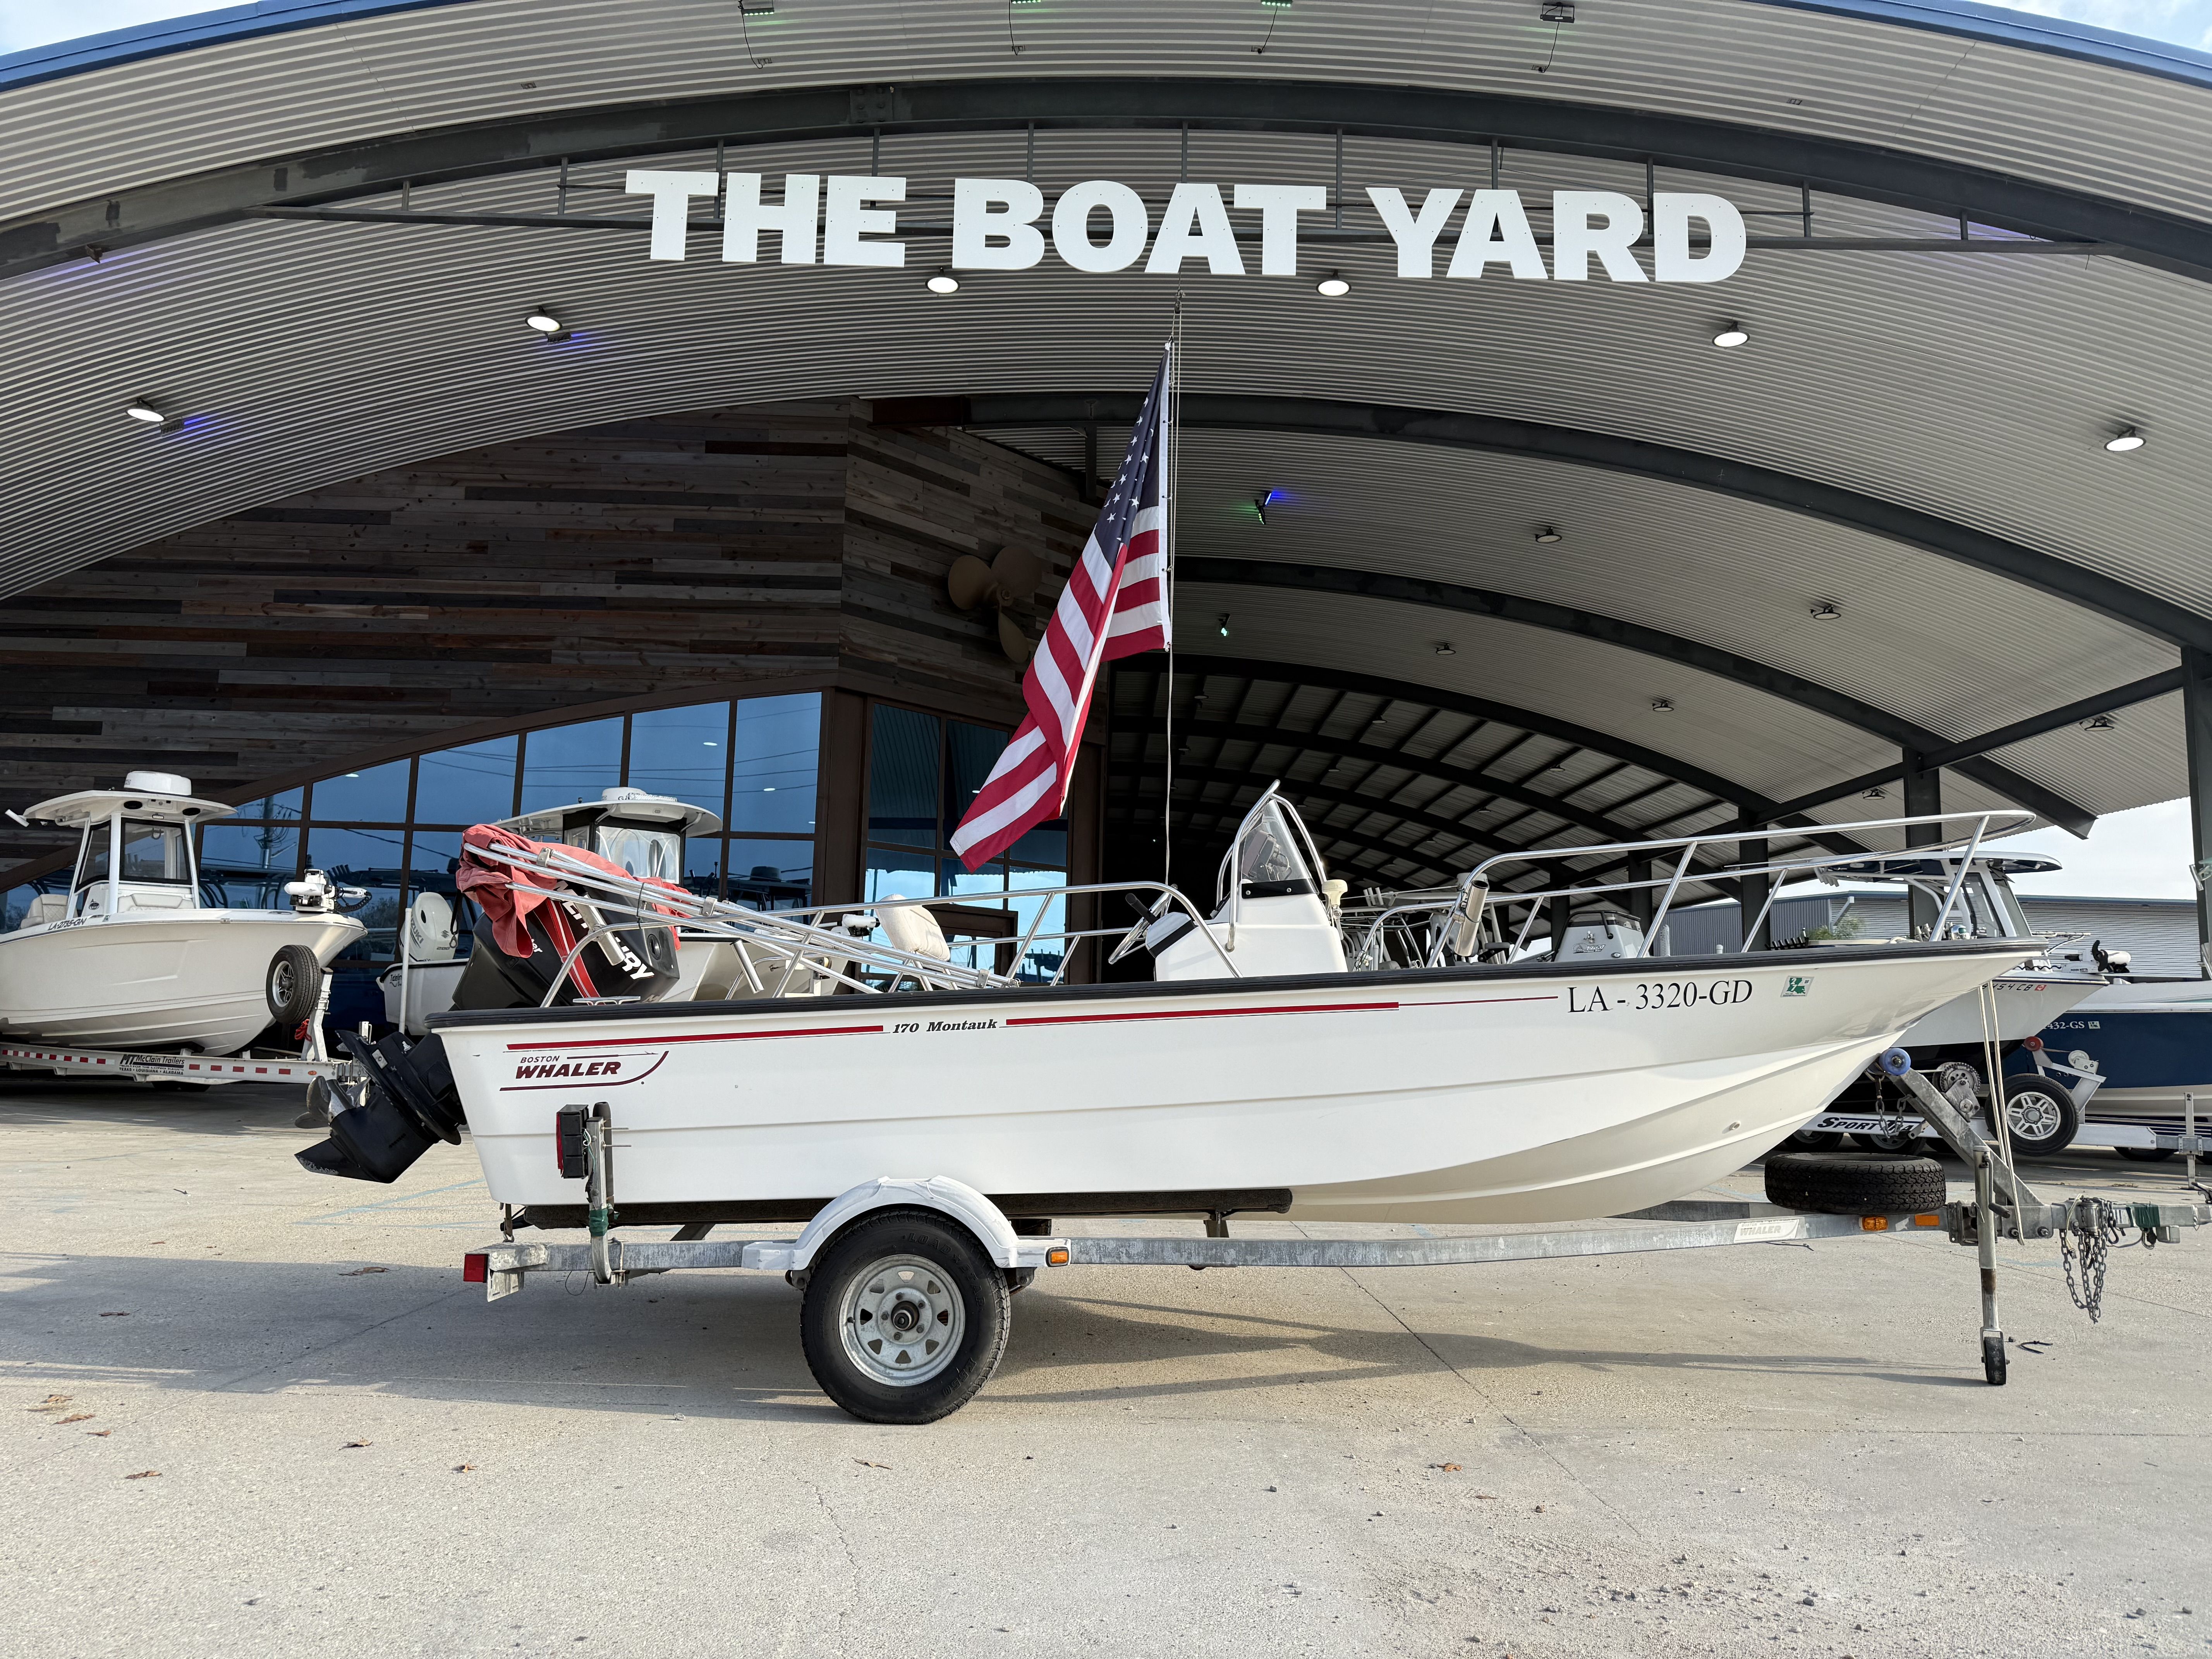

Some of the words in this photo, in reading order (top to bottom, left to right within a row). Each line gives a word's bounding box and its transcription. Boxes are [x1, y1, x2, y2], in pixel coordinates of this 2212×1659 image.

[625, 170, 906, 267] THE
[951, 178, 1327, 276] BOAT
[1365, 187, 1747, 283] YARD
[1567, 986, 1610, 1013] LA
[892, 1023, 919, 1033] 170
[926, 1019, 998, 1032] Montauk
[2045, 1021, 2085, 1029] 432-GS
[136, 1054, 161, 1063] McClain
[162, 1056, 185, 1065] Trailers
[520, 1055, 560, 1063] BOSTON
[515, 1061, 622, 1079] WHALER
[1817, 1117, 1877, 1130] SPORT
[1740, 1225, 1781, 1236] WHALER
